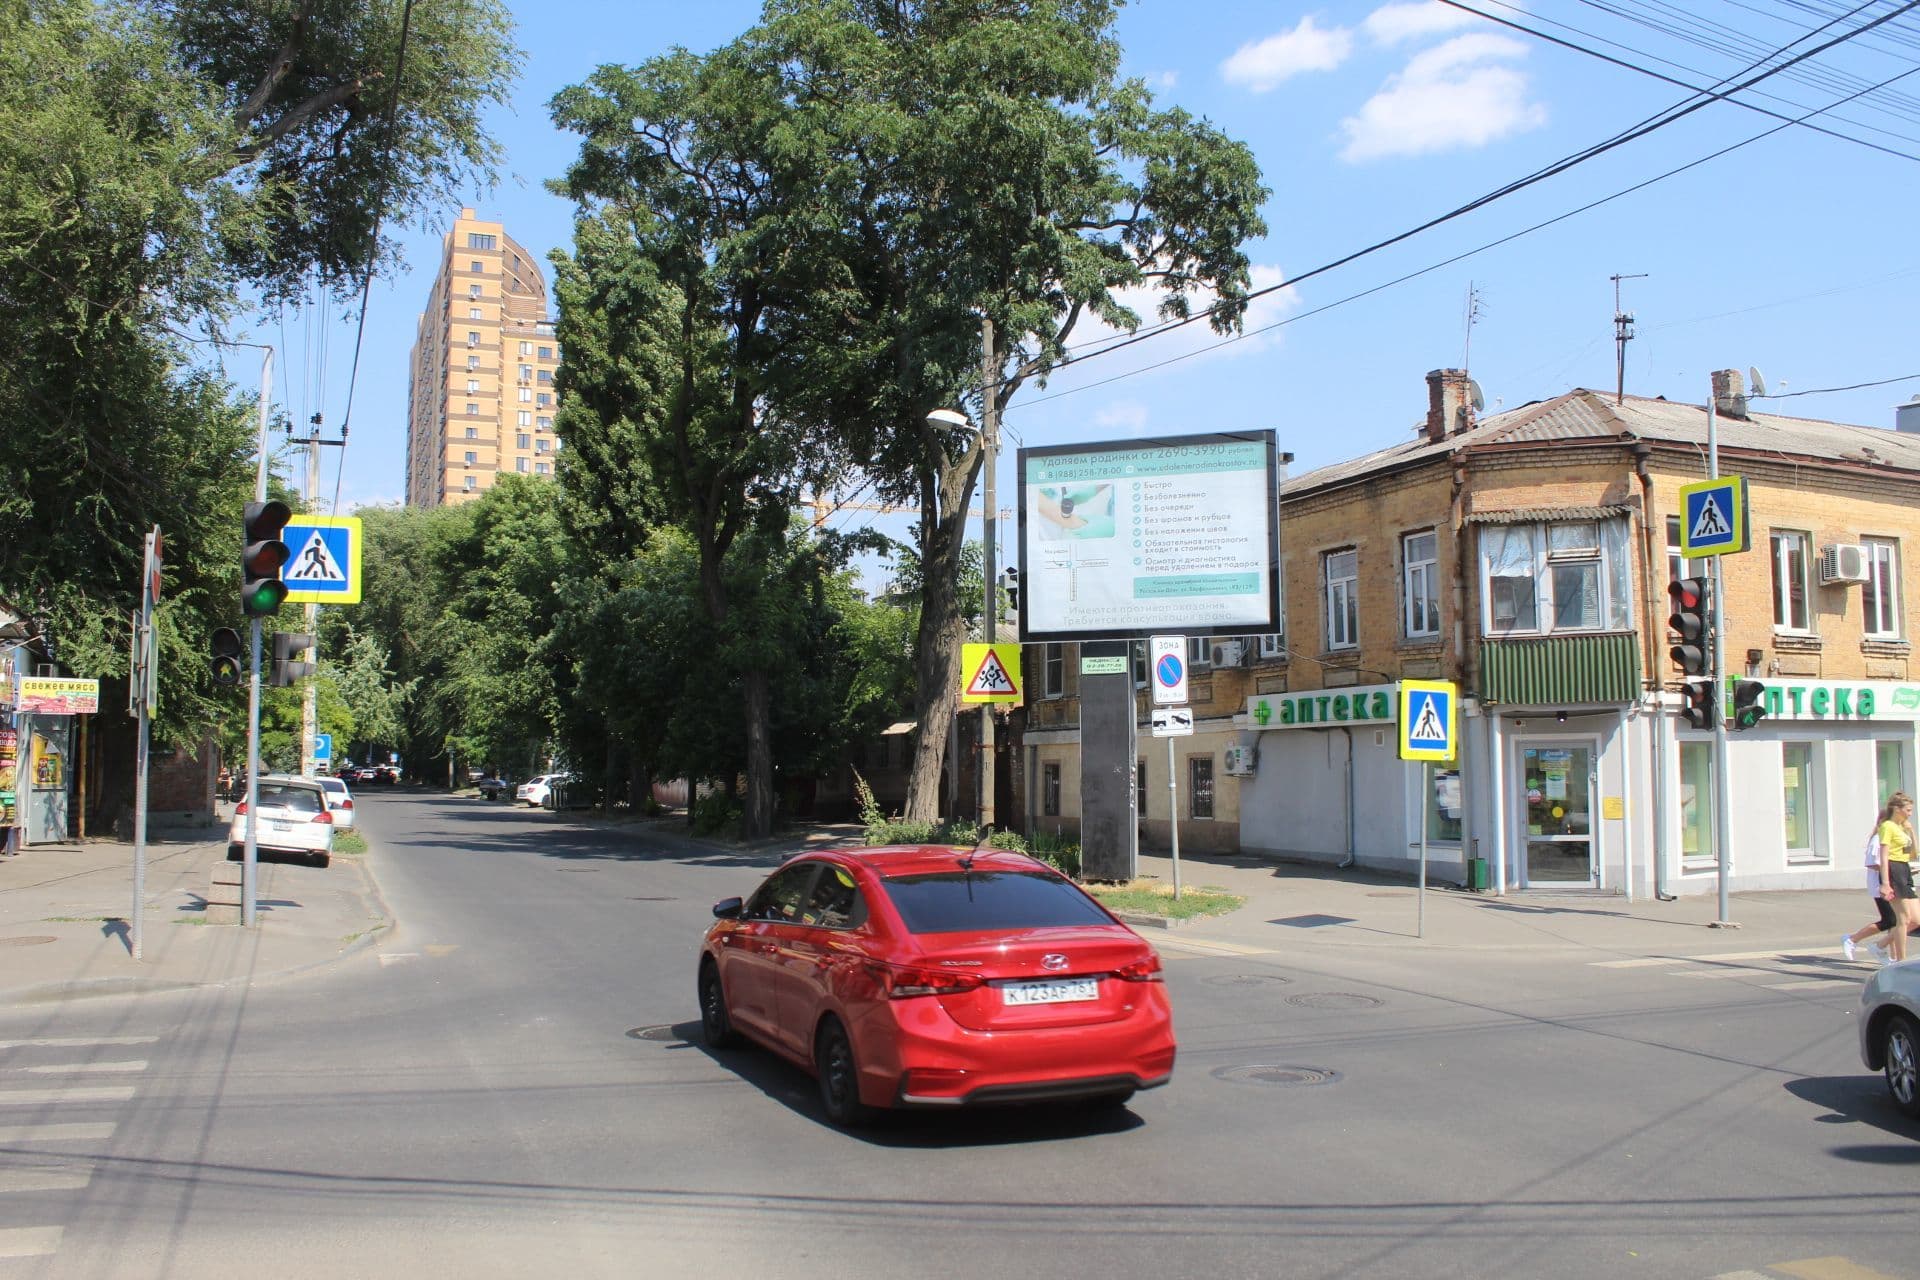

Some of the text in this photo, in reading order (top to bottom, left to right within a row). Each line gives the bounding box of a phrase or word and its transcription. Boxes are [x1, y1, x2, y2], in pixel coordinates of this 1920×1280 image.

[1042, 457, 1087, 467] Удаляем
[1091, 454, 1138, 465] родинки
[1141, 452, 1153, 460] от
[1158, 445, 1225, 459] 2690-3990
[1144, 481, 1172, 490] Быстро
[1144, 492, 1206, 500] Безболезненно
[1144, 503, 1194, 512] Без очереди
[1144, 516, 1158, 524] Без
[1201, 512, 1231, 522] рубцов
[1144, 528, 1158, 536] Без
[1161, 527, 1205, 535] наложения
[1145, 539, 1201, 547] Обязательная
[1145, 557, 1176, 565] Осмотр
[1185, 555, 1236, 564] диагностика
[1145, 564, 1169, 572] перед
[1172, 562, 1216, 571] удалением
[1224, 560, 1259, 568] подарок
[1069, 607, 1117, 615] Имеются
[1064, 616, 1117, 626] Требуется
[1159, 641, 1180, 650] ЗОНА
[1764, 686, 1875, 716] птека
[1280, 691, 1389, 724] аптека
